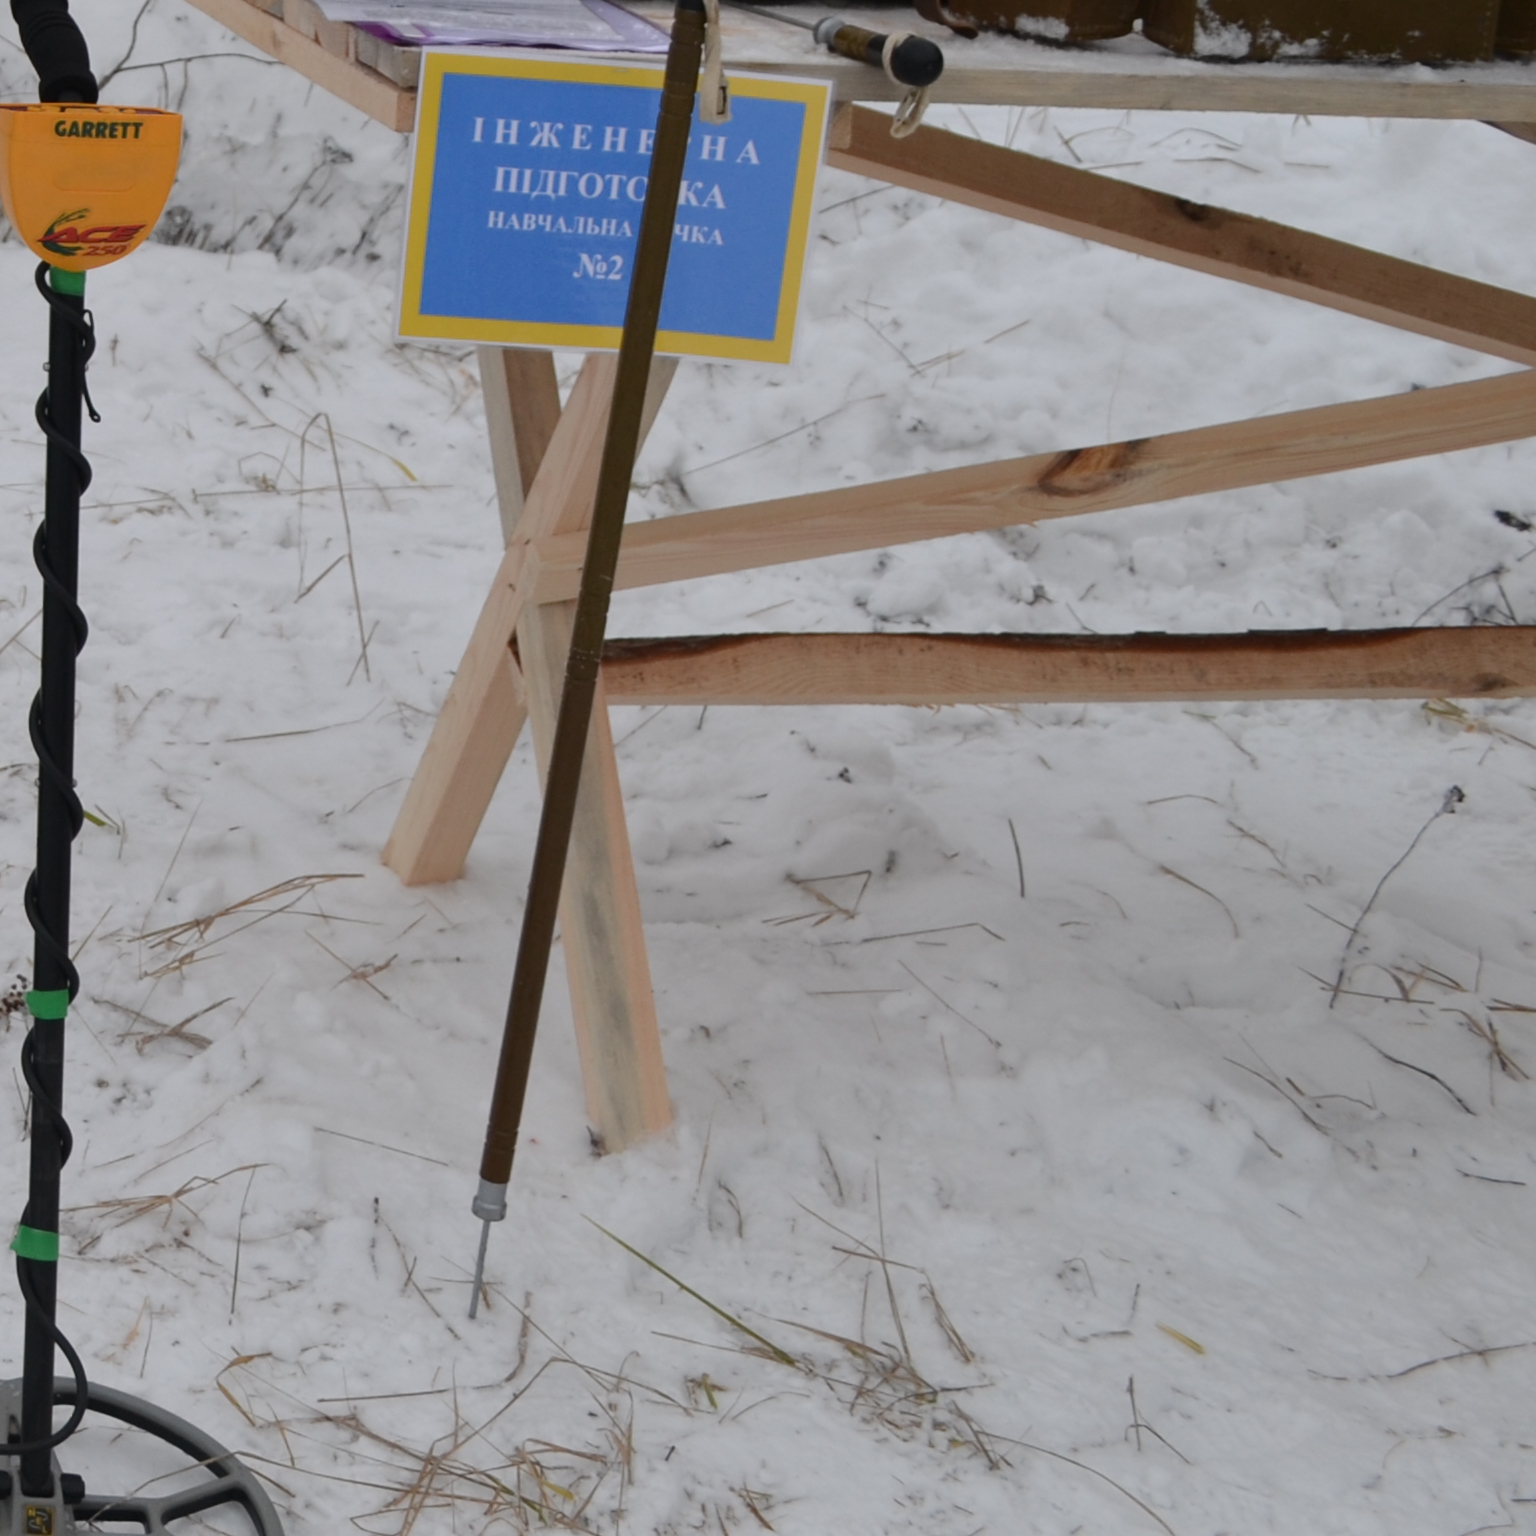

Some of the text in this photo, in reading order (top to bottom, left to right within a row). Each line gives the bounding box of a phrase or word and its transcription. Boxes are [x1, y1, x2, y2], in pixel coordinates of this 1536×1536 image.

[54, 120, 144, 139] GARRETT
[471, 116, 761, 165] ІНЖЕНЕНА
[492, 166, 727, 209] ПІДГОТОКА
[36, 224, 147, 244] ACE
[487, 210, 633, 237] НАВЧАЛЬНА
[82, 245, 127, 256] 250
[572, 252, 625, 280] №2
